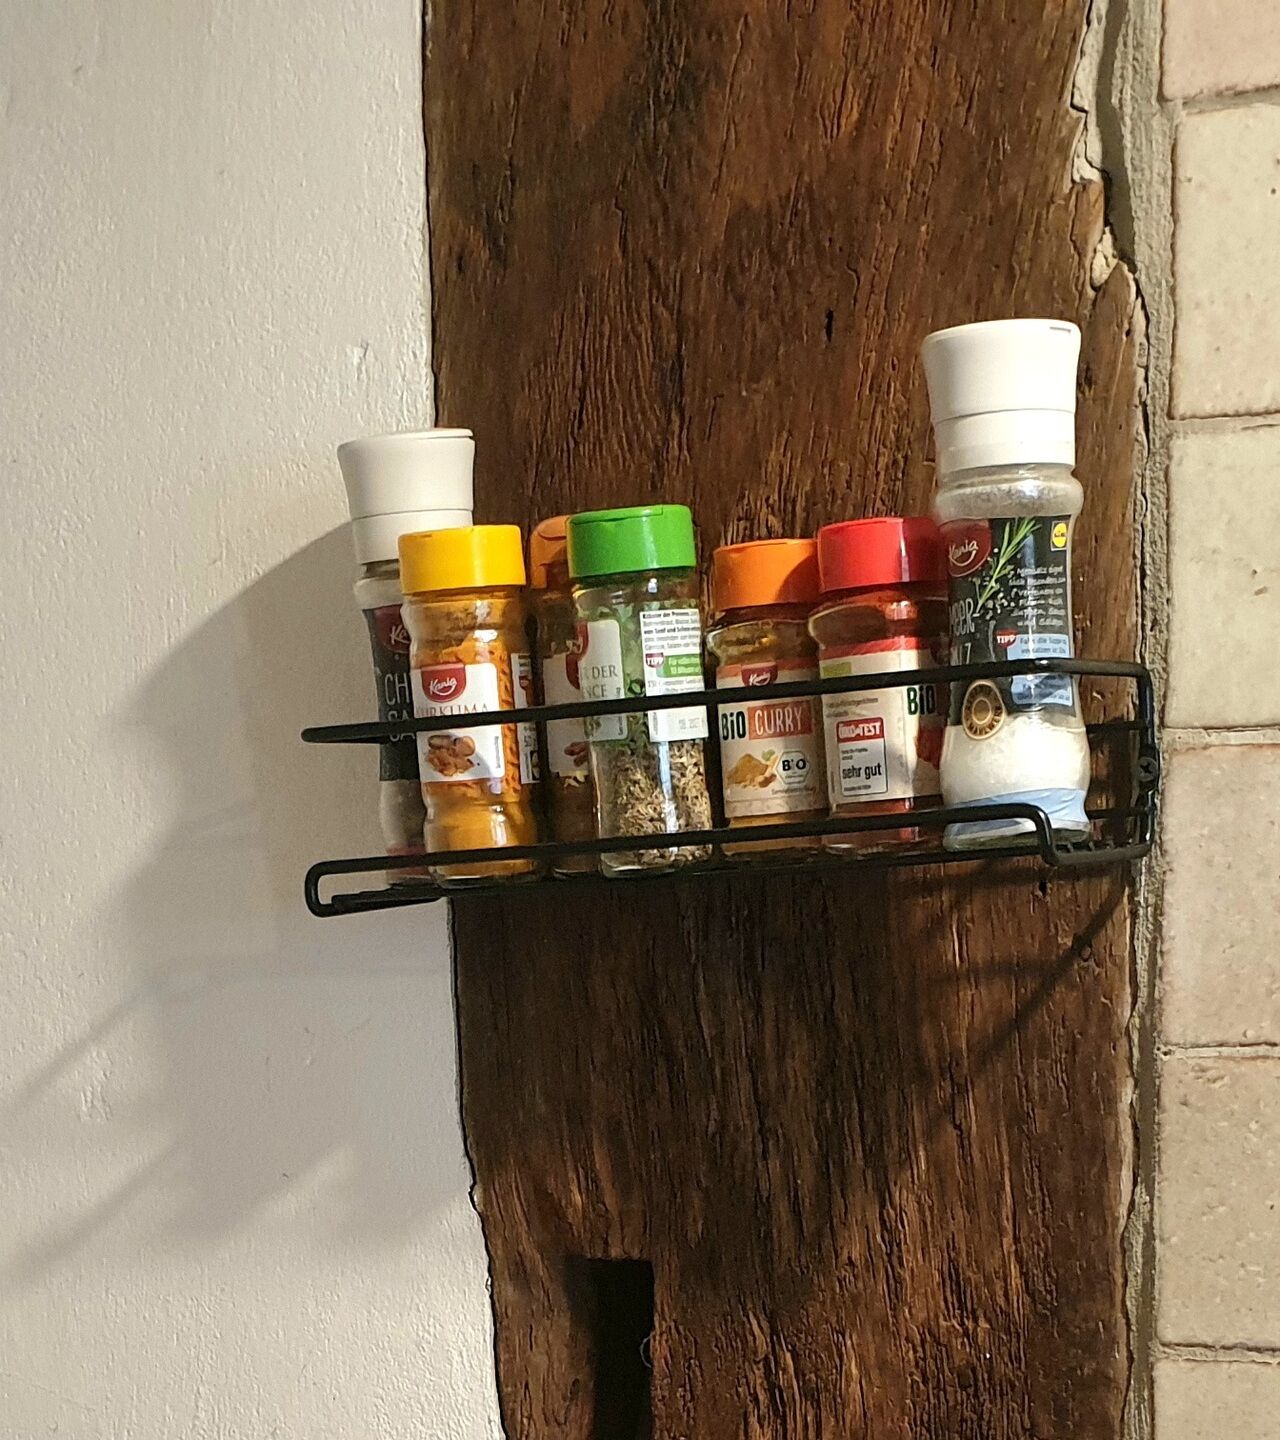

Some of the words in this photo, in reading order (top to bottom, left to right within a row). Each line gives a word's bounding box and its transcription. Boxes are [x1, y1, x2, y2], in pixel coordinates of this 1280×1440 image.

[996, 634, 1016, 644] TIPP
[591, 664, 618, 680] DER
[429, 677, 457, 696] Kania
[755, 706, 803, 736] CURRY
[842, 764, 861, 780] sehr
[864, 762, 882, 780] gut
